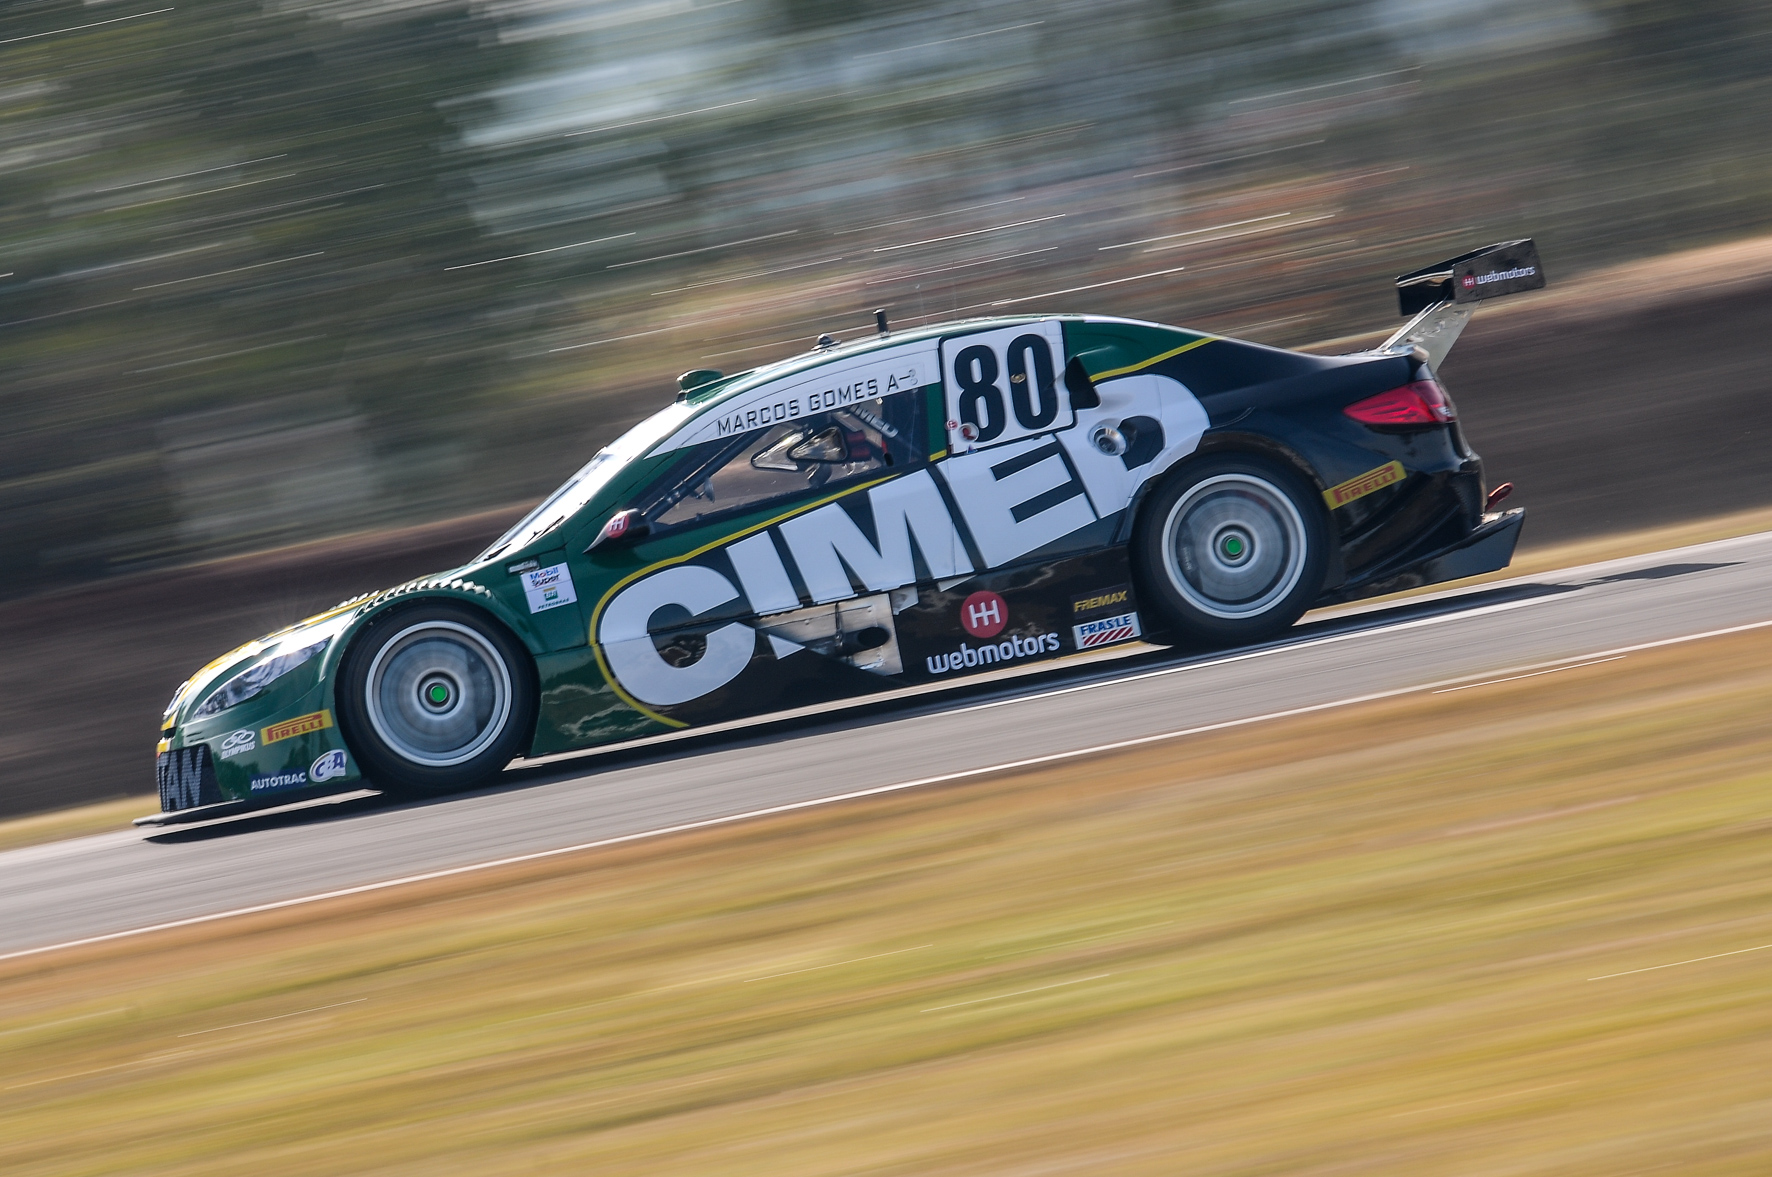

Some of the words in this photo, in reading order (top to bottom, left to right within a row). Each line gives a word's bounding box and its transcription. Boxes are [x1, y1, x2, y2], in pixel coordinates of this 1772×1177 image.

[1476, 266, 1536, 285] webmotors
[954, 334, 1060, 442] 80
[717, 400, 800, 436] MARCOS
[809, 378, 879, 411] GOMES
[1333, 465, 1397, 504] PIRELLI
[530, 567, 559, 580] Mobil
[1074, 590, 1127, 612] FREMAX
[926, 632, 1061, 674] webmotors
[267, 713, 323, 742] PIRELLI
[251, 772, 307, 791] AUTOTRAC
